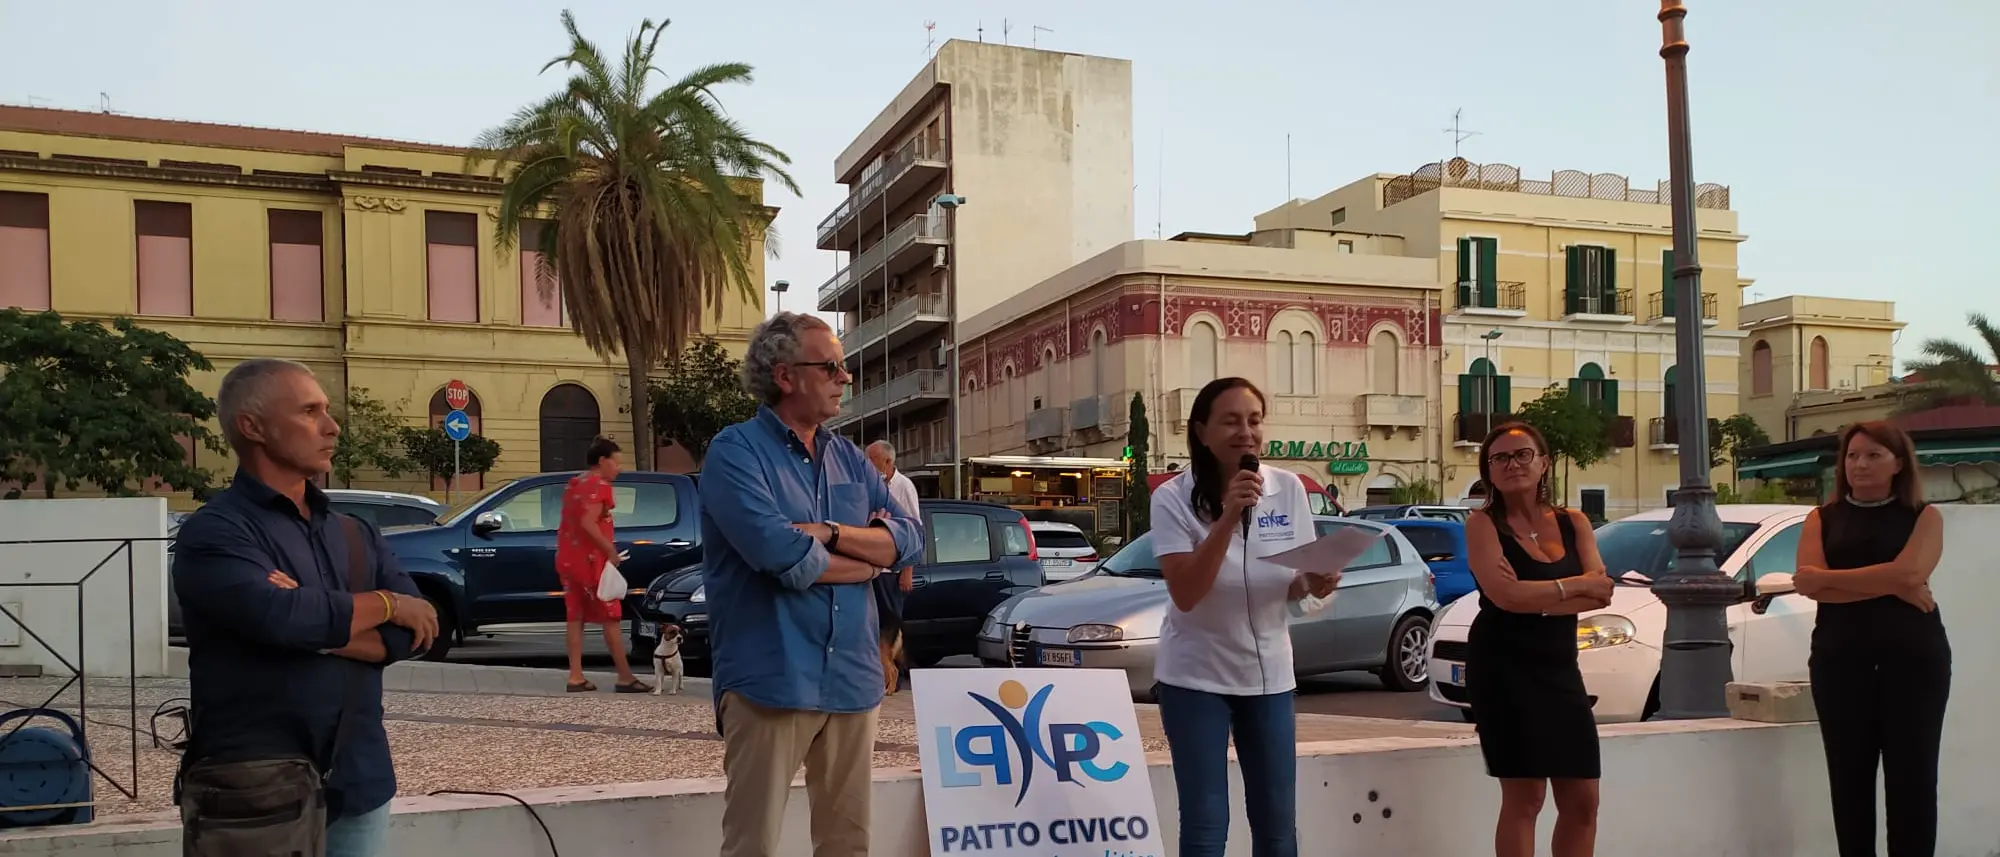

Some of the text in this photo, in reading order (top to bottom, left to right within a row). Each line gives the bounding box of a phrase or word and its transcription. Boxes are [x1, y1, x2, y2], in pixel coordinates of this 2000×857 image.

[447, 387, 469, 400] STOP
[1268, 440, 1370, 458] RMACIA
[940, 816, 1149, 852] PATTO CIVICO
